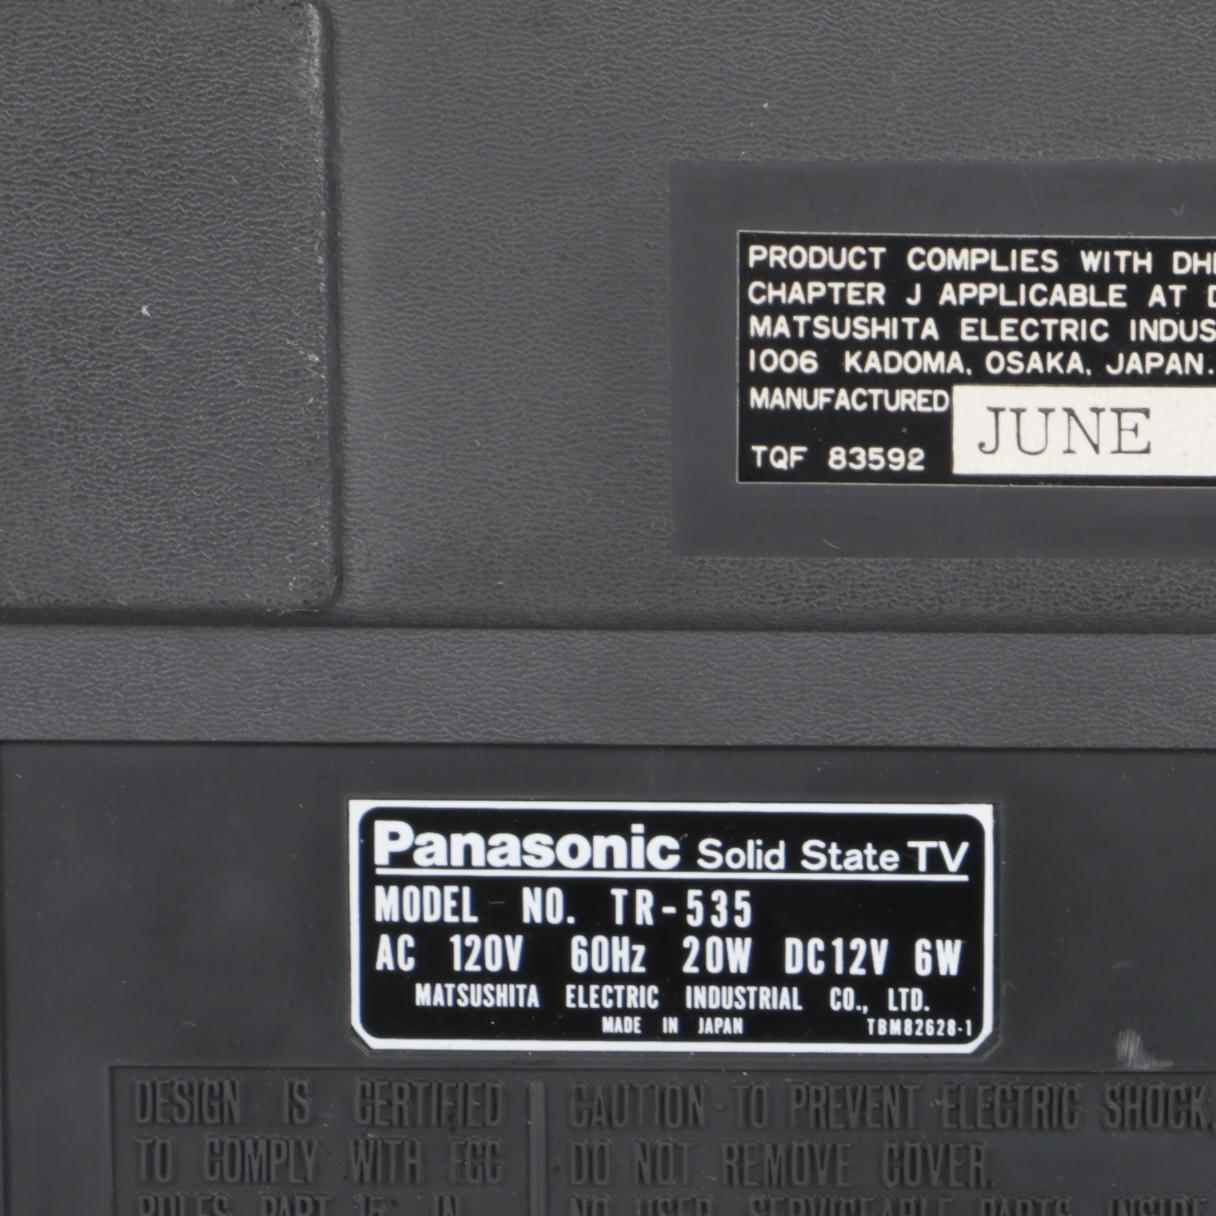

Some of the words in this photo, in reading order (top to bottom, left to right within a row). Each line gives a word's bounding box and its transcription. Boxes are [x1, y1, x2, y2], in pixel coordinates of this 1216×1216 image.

[748, 245, 886, 270] PRODUCT
[907, 247, 1059, 273] COMPLIES
[1080, 250, 1152, 274] WITH
[747, 281, 886, 306] CHAPTER
[906, 283, 922, 306] J
[938, 283, 1127, 308] APPLICABLE
[1148, 284, 1187, 308] AT
[749, 315, 939, 341] MATSUSHITA
[960, 317, 1110, 342] ELECTRIC
[748, 349, 818, 374] 1006
[844, 351, 972, 376] KADOMA,
[985, 351, 1092, 376] OSAKA,
[1106, 353, 1214, 376] JAPAN.
[749, 387, 949, 413] MANUFACTURED
[978, 406, 1152, 456] JUNE
[751, 445, 808, 471] TQF
[827, 445, 925, 471] 83592
[374, 820, 680, 870] Panasonic
[697, 838, 785, 870] Solid
[800, 839, 900, 871] State
[907, 840, 969, 873] TV
[374, 885, 479, 923] MODEL
[522, 886, 575, 925] NO.
[610, 888, 751, 928] TR-535
[375, 933, 415, 972] AC
[450, 933, 523, 972] 120V
[570, 935, 646, 973] 60Hz
[682, 935, 752, 975] 20W
[914, 938, 962, 976] 6W
[415, 982, 540, 1008] MATSUSHITA
[565, 984, 659, 1010] ELECTRIC
[685, 985, 803, 1011] INDUSTRIAL
[829, 987, 869, 1015] CO.,
[887, 987, 930, 1012] LTD.
[601, 1016, 642, 1034] MADE
[662, 1016, 679, 1035] IN
[698, 1017, 744, 1035] JAPAN
[867, 1018, 972, 1037] TBM82628-1
[134, 1077, 241, 1126] DESIGN
[281, 1077, 313, 1126] IS
[353, 1078, 505, 1128] CERTIFIED
[568, 1080, 708, 1129] CAUTION
[731, 1080, 771, 1129] TO
[787, 1080, 919, 1129] PREVENT
[941, 1080, 1082, 1130] ELECTRIC
[135, 1136, 176, 1184] TO
[202, 1134, 322, 1185] COMPLY
[347, 1135, 422, 1185] WITH
[448, 1136, 503, 1185] FCC
[569, 1137, 616, 1186] DO
[633, 1138, 697, 1186] NOT
[721, 1139, 854, 1188] REMOVE
